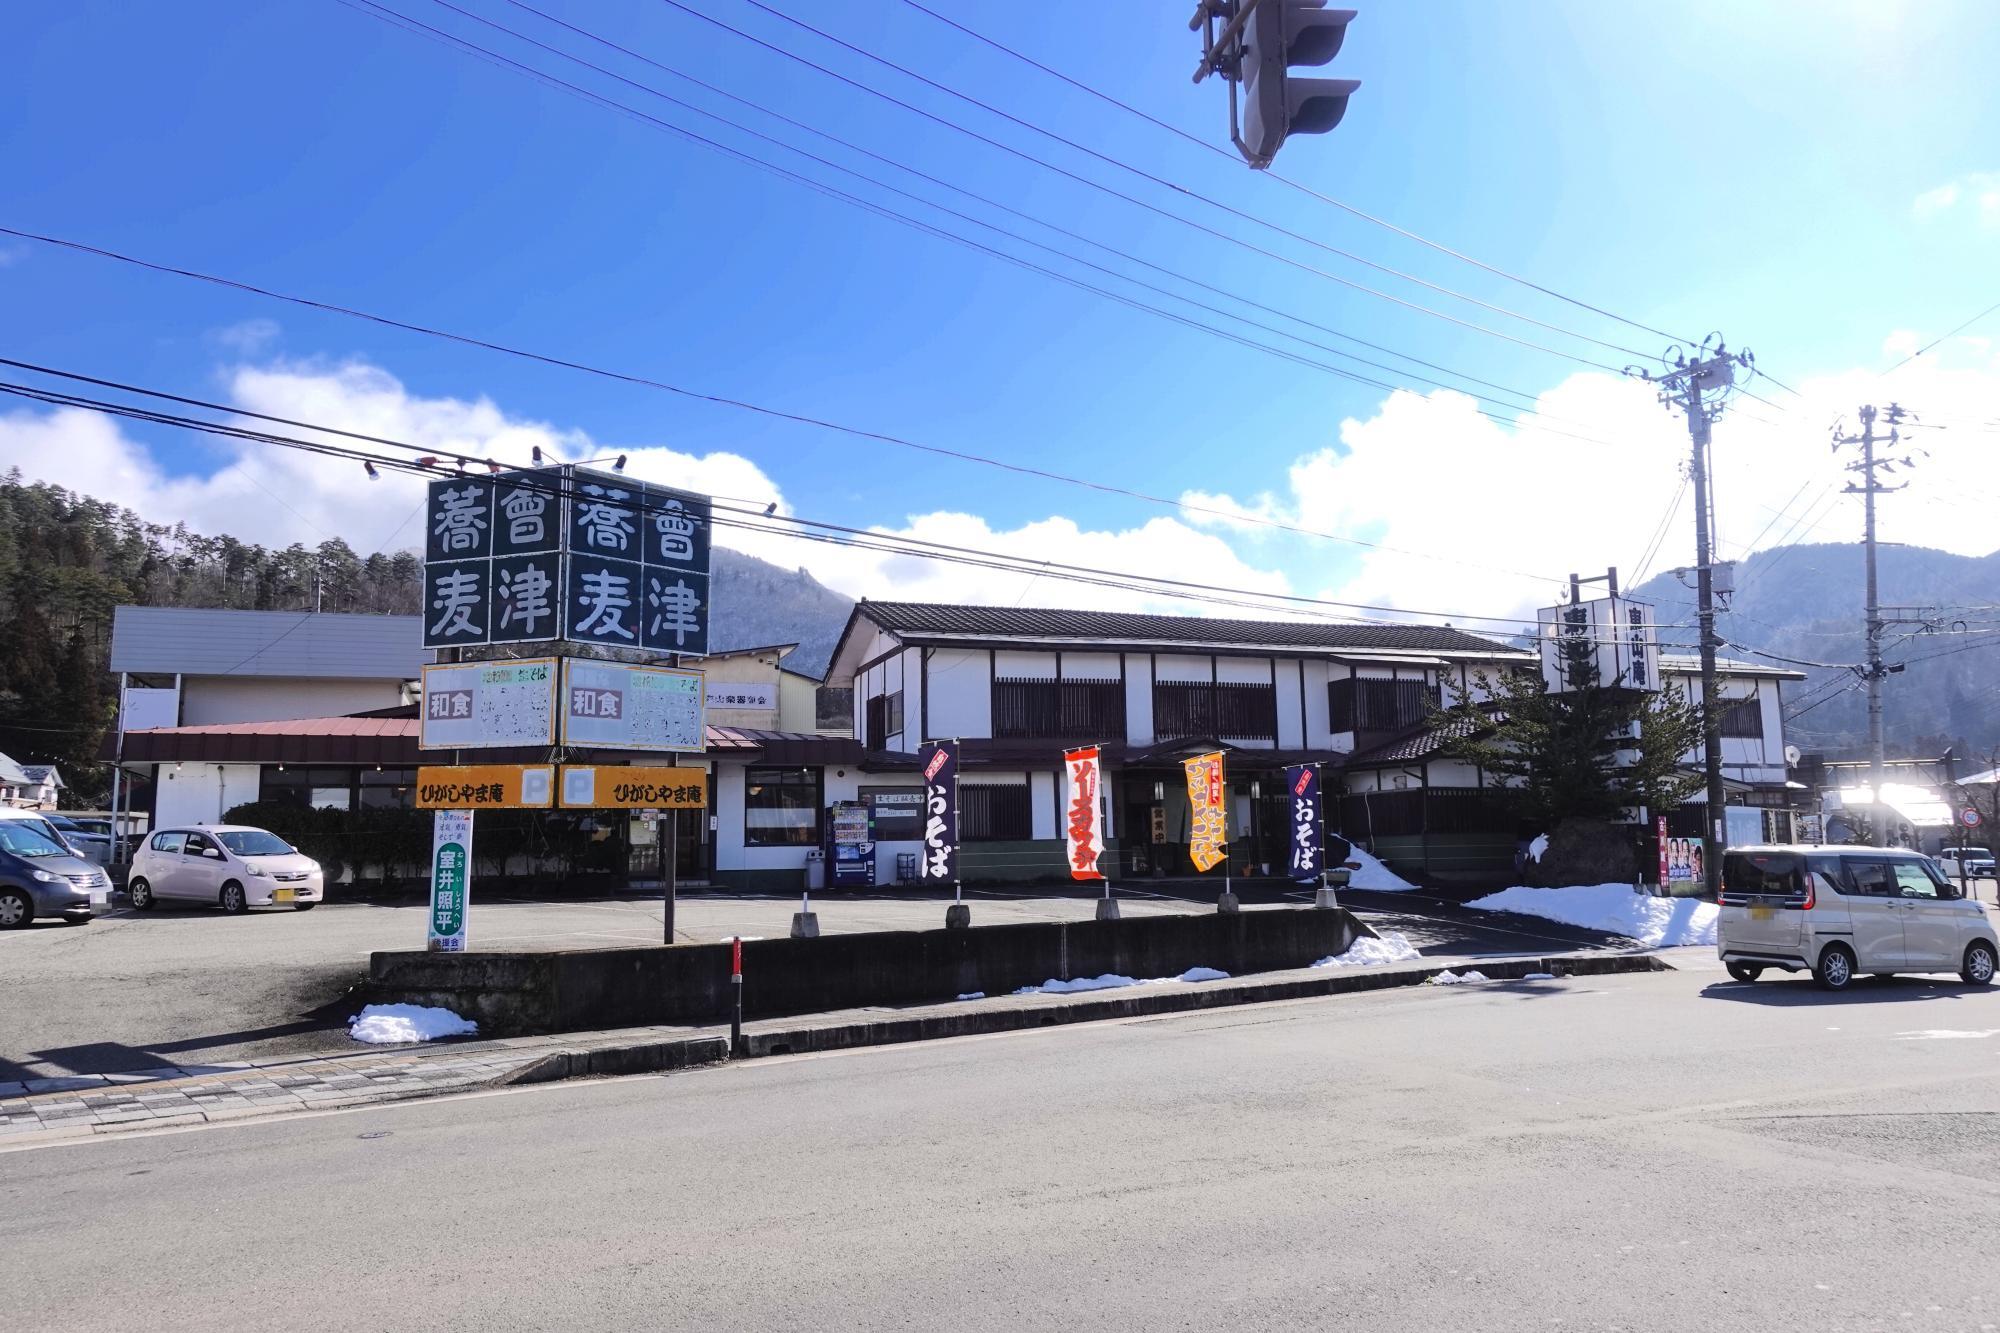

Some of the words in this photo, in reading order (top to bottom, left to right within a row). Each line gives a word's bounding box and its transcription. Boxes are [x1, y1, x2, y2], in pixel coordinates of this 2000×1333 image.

[431, 692, 471, 717] 和食
[573, 690, 621, 718] 和食
[420, 783, 504, 804] ひがしやま庵
[526, 774, 547, 799] P
[568, 774, 590, 799] P
[613, 783, 702, 804] ひがしやま庵
[921, 784, 952, 879] おそば
[1293, 798, 1318, 871] おそば
[436, 850, 456, 931] 室井照平
